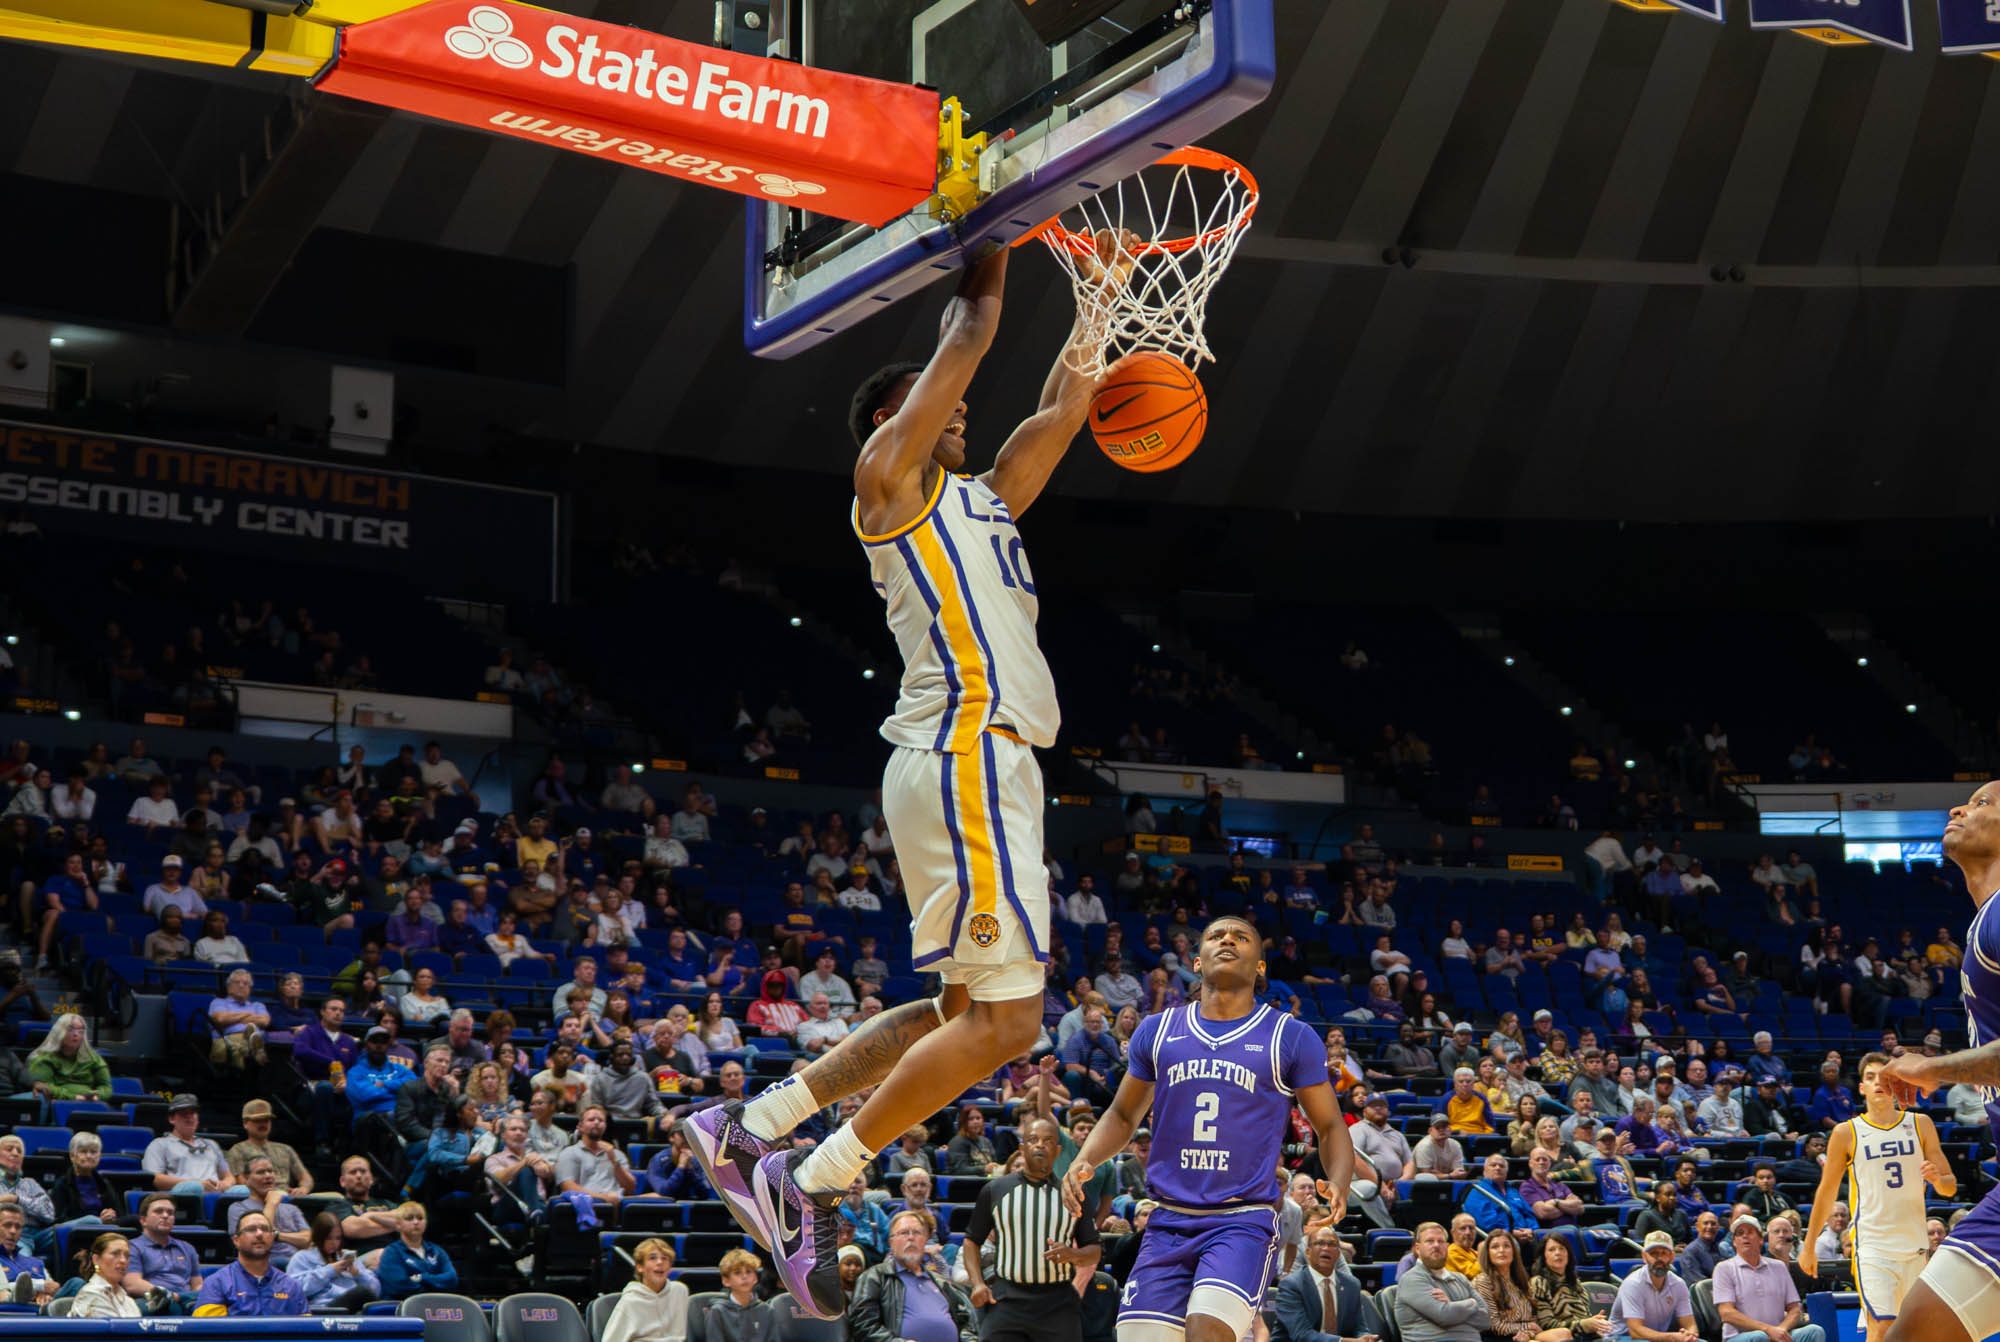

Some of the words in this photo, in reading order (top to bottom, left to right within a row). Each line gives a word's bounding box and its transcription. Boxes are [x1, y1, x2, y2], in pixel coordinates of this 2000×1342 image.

[540, 25, 829, 138] StateFarm
[489, 111, 754, 183] StateFarm
[1104, 431, 1163, 457] ELITE
[0, 428, 117, 474] ETE
[135, 446, 411, 512] MARAVICH
[236, 500, 410, 550] CENTER
[990, 534, 1037, 596] 10
[1167, 1058, 1257, 1094] TARLETON
[1192, 1092, 1220, 1142] 2
[1180, 1148, 1230, 1172] STATE
[1864, 1140, 1915, 1160] LSU
[1884, 1161, 1904, 1189] 3
[424, 1307, 463, 1321] LSU
[520, 1308, 558, 1321] LSU
